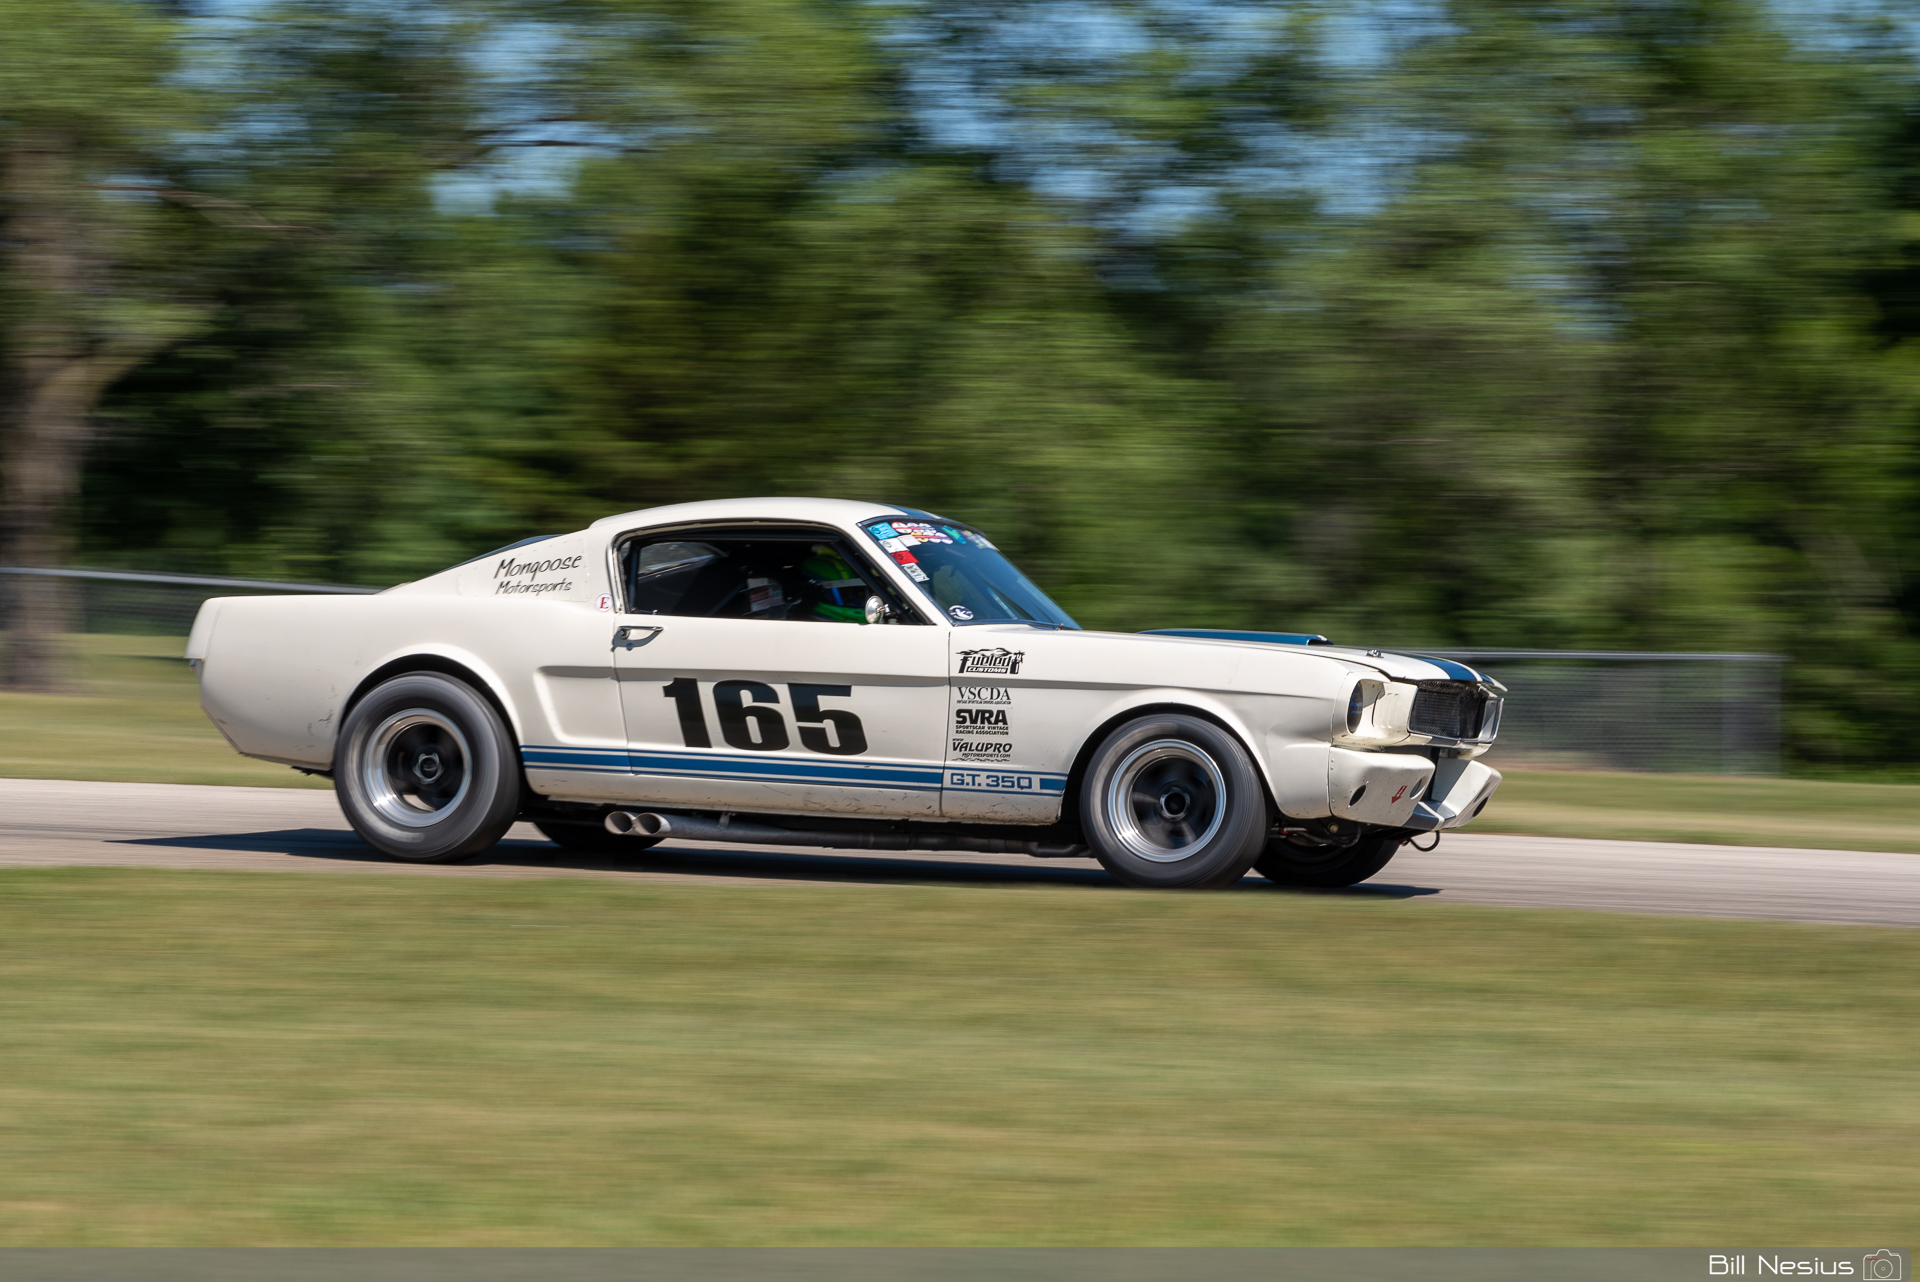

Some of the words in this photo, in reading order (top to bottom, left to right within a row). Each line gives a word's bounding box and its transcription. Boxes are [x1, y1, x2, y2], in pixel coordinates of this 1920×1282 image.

[494, 555, 582, 582] Mongoose
[495, 578, 573, 597] Motorsports
[599, 596, 610, 609] E
[957, 686, 1011, 701] VSCDA
[662, 677, 868, 756] 165
[956, 709, 1008, 725] SVRA
[952, 742, 1013, 753] VALUPRO
[950, 773, 981, 787] G.T.
[986, 775, 1032, 789] 350
